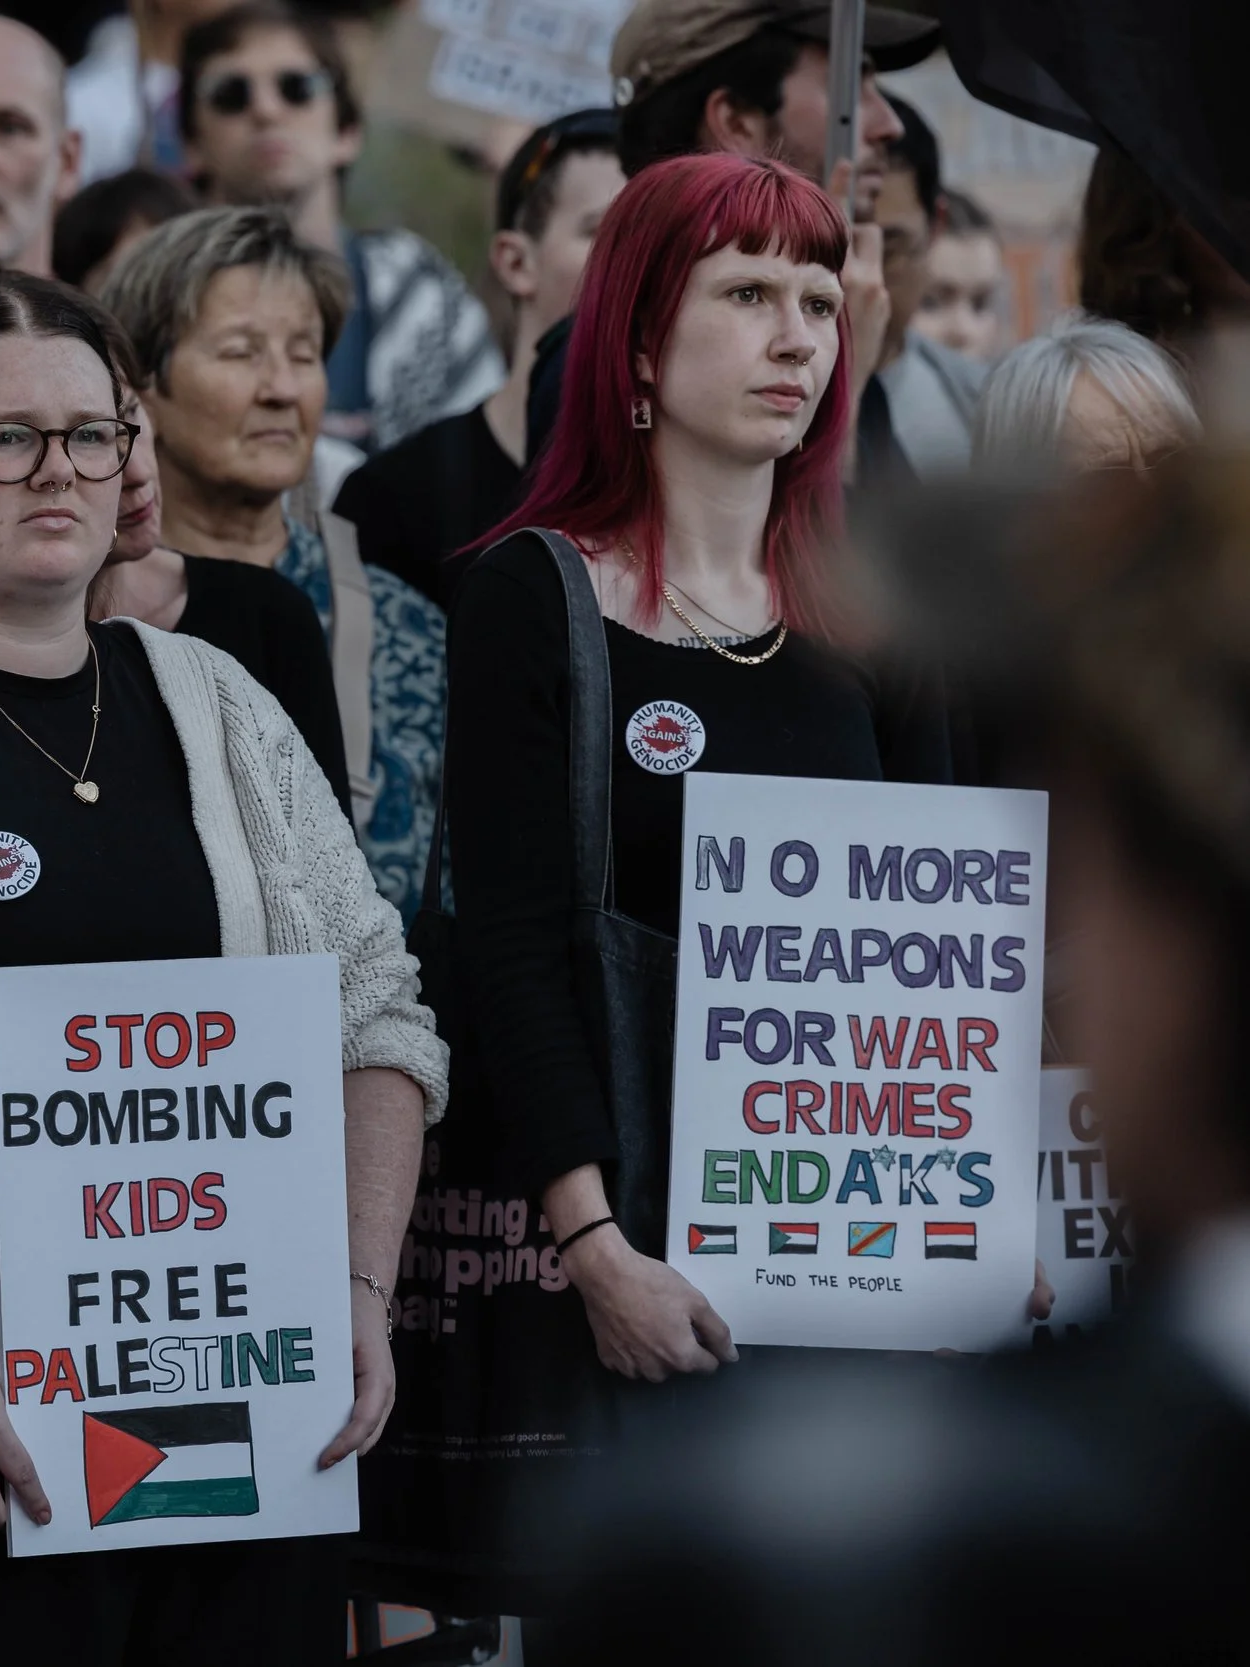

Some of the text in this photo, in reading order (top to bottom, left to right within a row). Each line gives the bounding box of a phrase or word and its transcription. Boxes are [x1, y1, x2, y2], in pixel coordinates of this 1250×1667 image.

[632, 702, 703, 735] HUMANITY
[630, 739, 697, 771] GENOCIDE
[848, 844, 1031, 905] MORE
[697, 921, 1027, 993] WEAPONS
[63, 1010, 237, 1073] STOP
[704, 1006, 1000, 1073] FOR WAR
[1, 1081, 292, 1147] BOMBING
[741, 1079, 973, 1140] CRIMES
[82, 1171, 229, 1239] KIDS
[701, 1148, 831, 1205] END
[67, 1262, 249, 1327] FREE
[399, 1233, 570, 1296] hopping
[755, 1268, 904, 1293] FUND THE PEOPLE
[6, 1326, 317, 1405] PALESTINE
